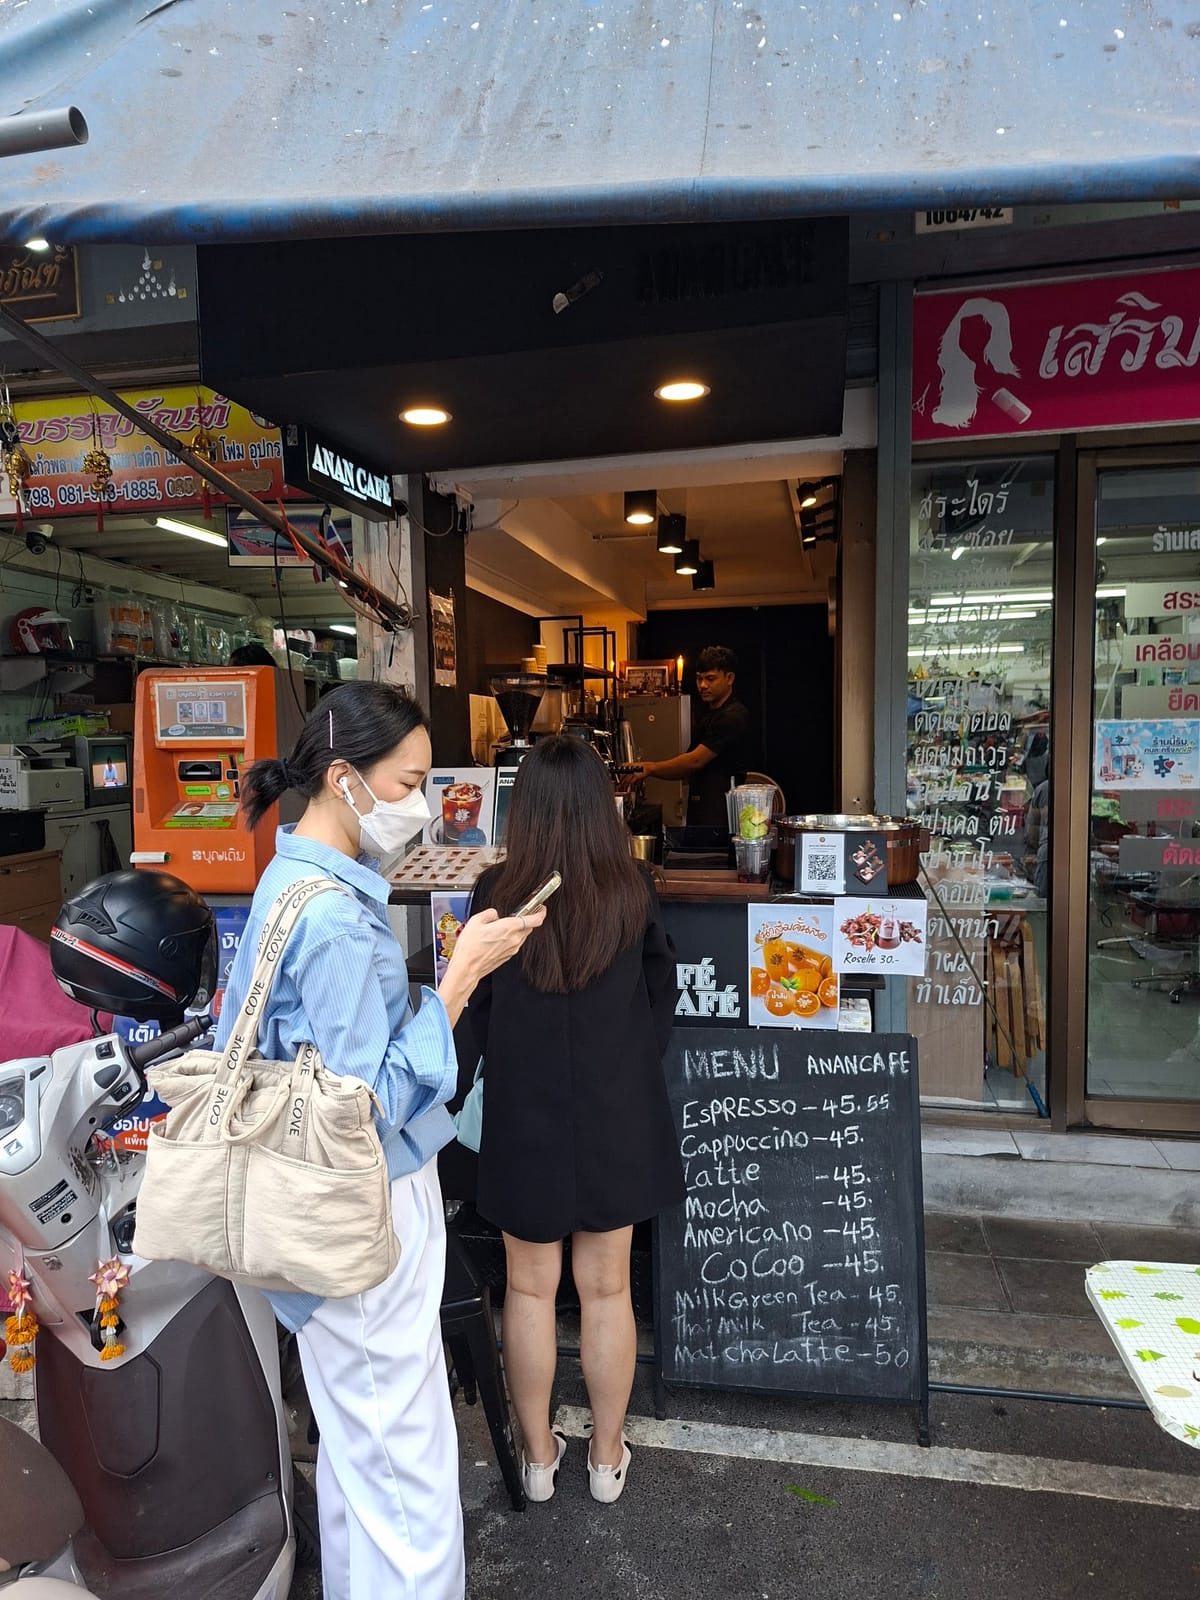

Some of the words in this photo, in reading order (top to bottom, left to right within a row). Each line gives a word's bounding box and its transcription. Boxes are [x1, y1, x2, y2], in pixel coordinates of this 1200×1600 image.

[220, 436, 244, 461] โฟม
[312, 443, 355, 491] ANAN
[355, 467, 393, 507] CAFÉ
[1168, 688, 1200, 711] ยืด
[258, 923, 270, 954] COV
[927, 911, 999, 940] ต่งหน้า
[266, 926, 287, 962] COVE
[843, 951, 877, 965] Roselle
[880, 955, 900, 964] 30.-
[244, 980, 265, 1016] COVE
[674, 985, 741, 1018] AFÉ
[227, 1034, 245, 1071] COVE
[301, 1047, 314, 1076] OVE
[684, 1044, 779, 1083] MENU
[210, 1087, 229, 1125] COVE
[289, 1097, 304, 1136] COVE
[680, 1125, 809, 1161] Cappuccino
[683, 1157, 760, 1191] Latte
[685, 1187, 769, 1220] Mocha
[684, 1217, 812, 1248] Americano
[804, 1281, 847, 1305] Tea
[792, 1311, 842, 1333] Tea
